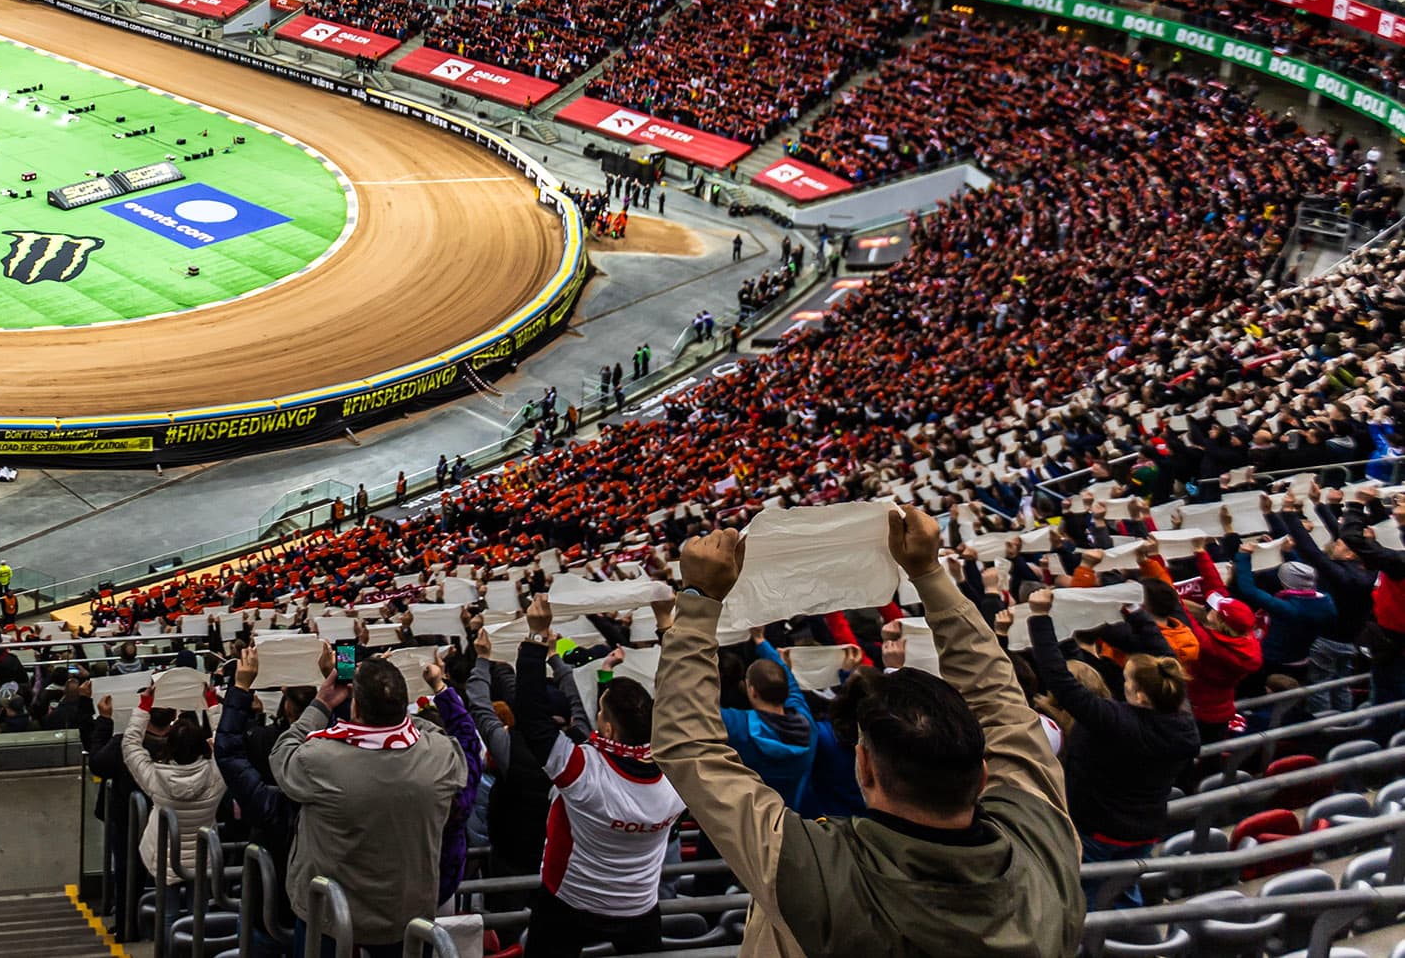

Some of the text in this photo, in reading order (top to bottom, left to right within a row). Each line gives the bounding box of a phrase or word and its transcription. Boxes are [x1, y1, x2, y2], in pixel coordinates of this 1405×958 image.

[1073, 3, 1114, 24] BOLL
[1122, 16, 1165, 37] BOLL
[338, 32, 371, 45] ORLEN
[1176, 28, 1214, 51] BOLL
[1222, 42, 1264, 66] BOLL
[472, 70, 511, 85] ORLEN
[1268, 57, 1307, 82] BOLL
[1315, 73, 1350, 100] BOLL
[1352, 90, 1388, 118] BOLL
[648, 124, 694, 143] ORLEN
[124, 202, 215, 243] events.com
[342, 365, 458, 418] #FIMSPEEDWAYGP
[4, 430, 27, 439] DON'T
[28, 430, 48, 439] MISS
[49, 430, 65, 438] ANY
[165, 407, 317, 445] #FIMSPEEDWAYGP
[21, 442, 35, 451] THE
[36, 442, 76, 452] SPEEDWAY
[76, 441, 129, 451] APPLICATION!
